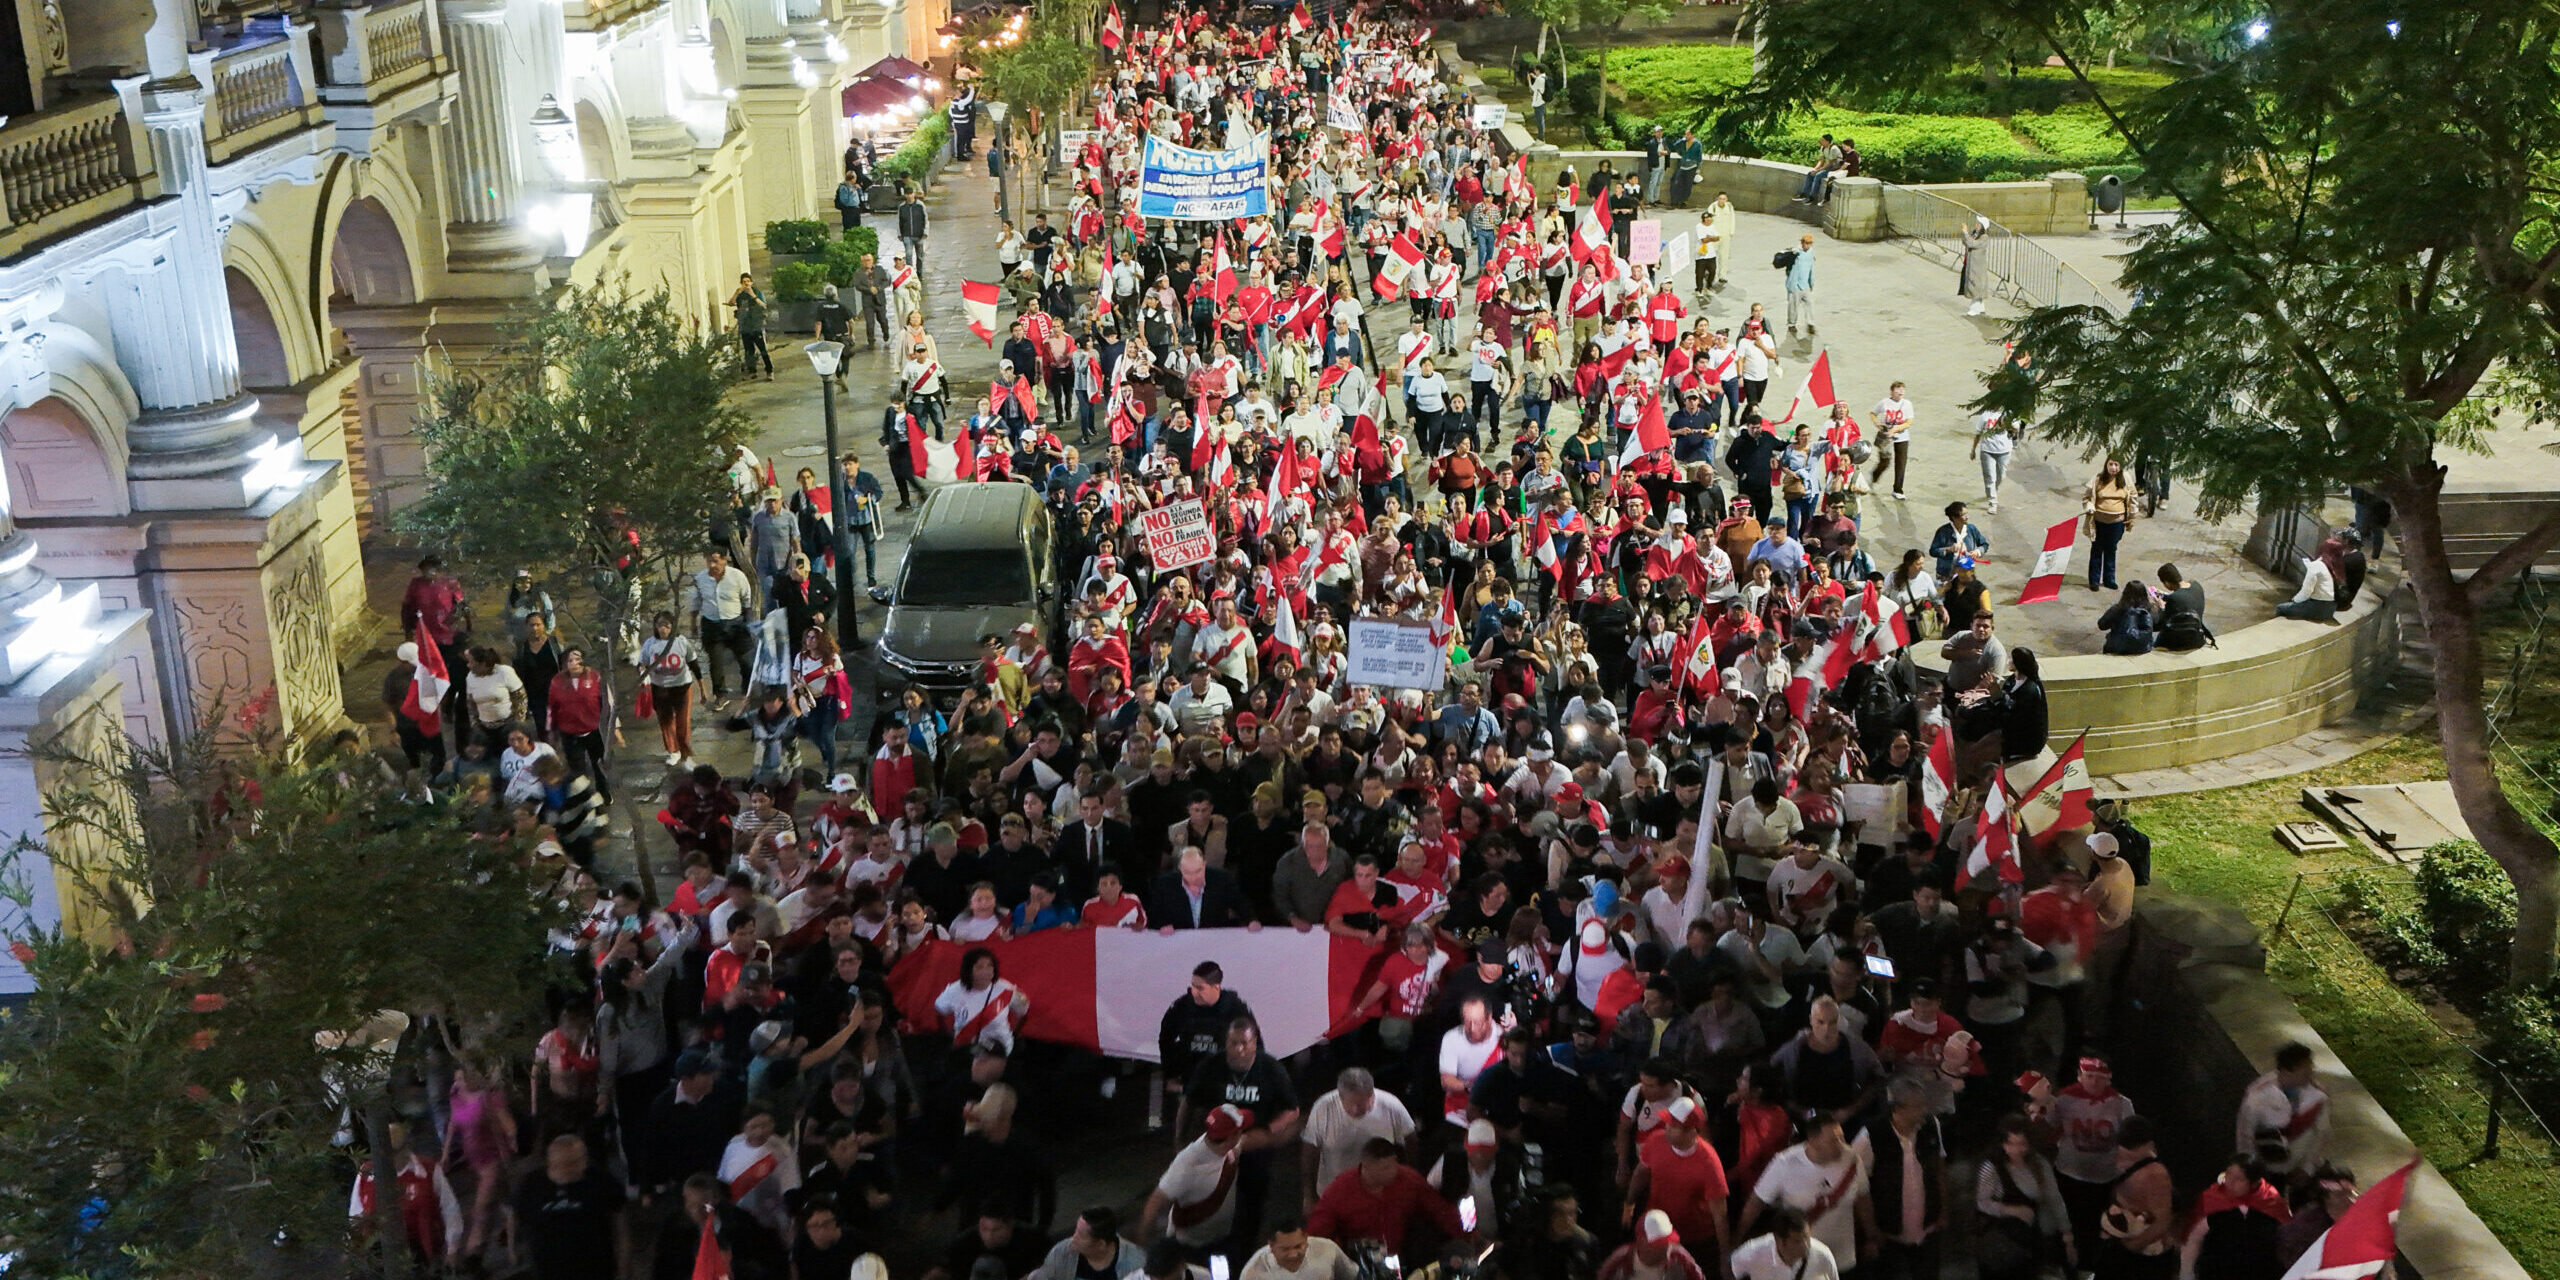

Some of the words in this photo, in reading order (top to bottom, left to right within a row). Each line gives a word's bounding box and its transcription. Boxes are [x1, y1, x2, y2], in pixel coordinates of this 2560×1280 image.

[1215, 172, 1234, 183] DEL
[1236, 167, 1259, 181] VOTO
[1211, 181, 1252, 195] POPULAR
[1480, 349, 1495, 360] NO
[1886, 409, 1903, 423] NO
[1170, 506, 1201, 519] SEGUNDA
[1172, 512, 1203, 525] VUELTA
[1145, 511, 1170, 532] NO
[1150, 531, 1174, 549] NO
[1176, 528, 1206, 542] FRAUDE
[1644, 1106, 1651, 1119] 9
[2072, 1117, 2113, 1137] NO
